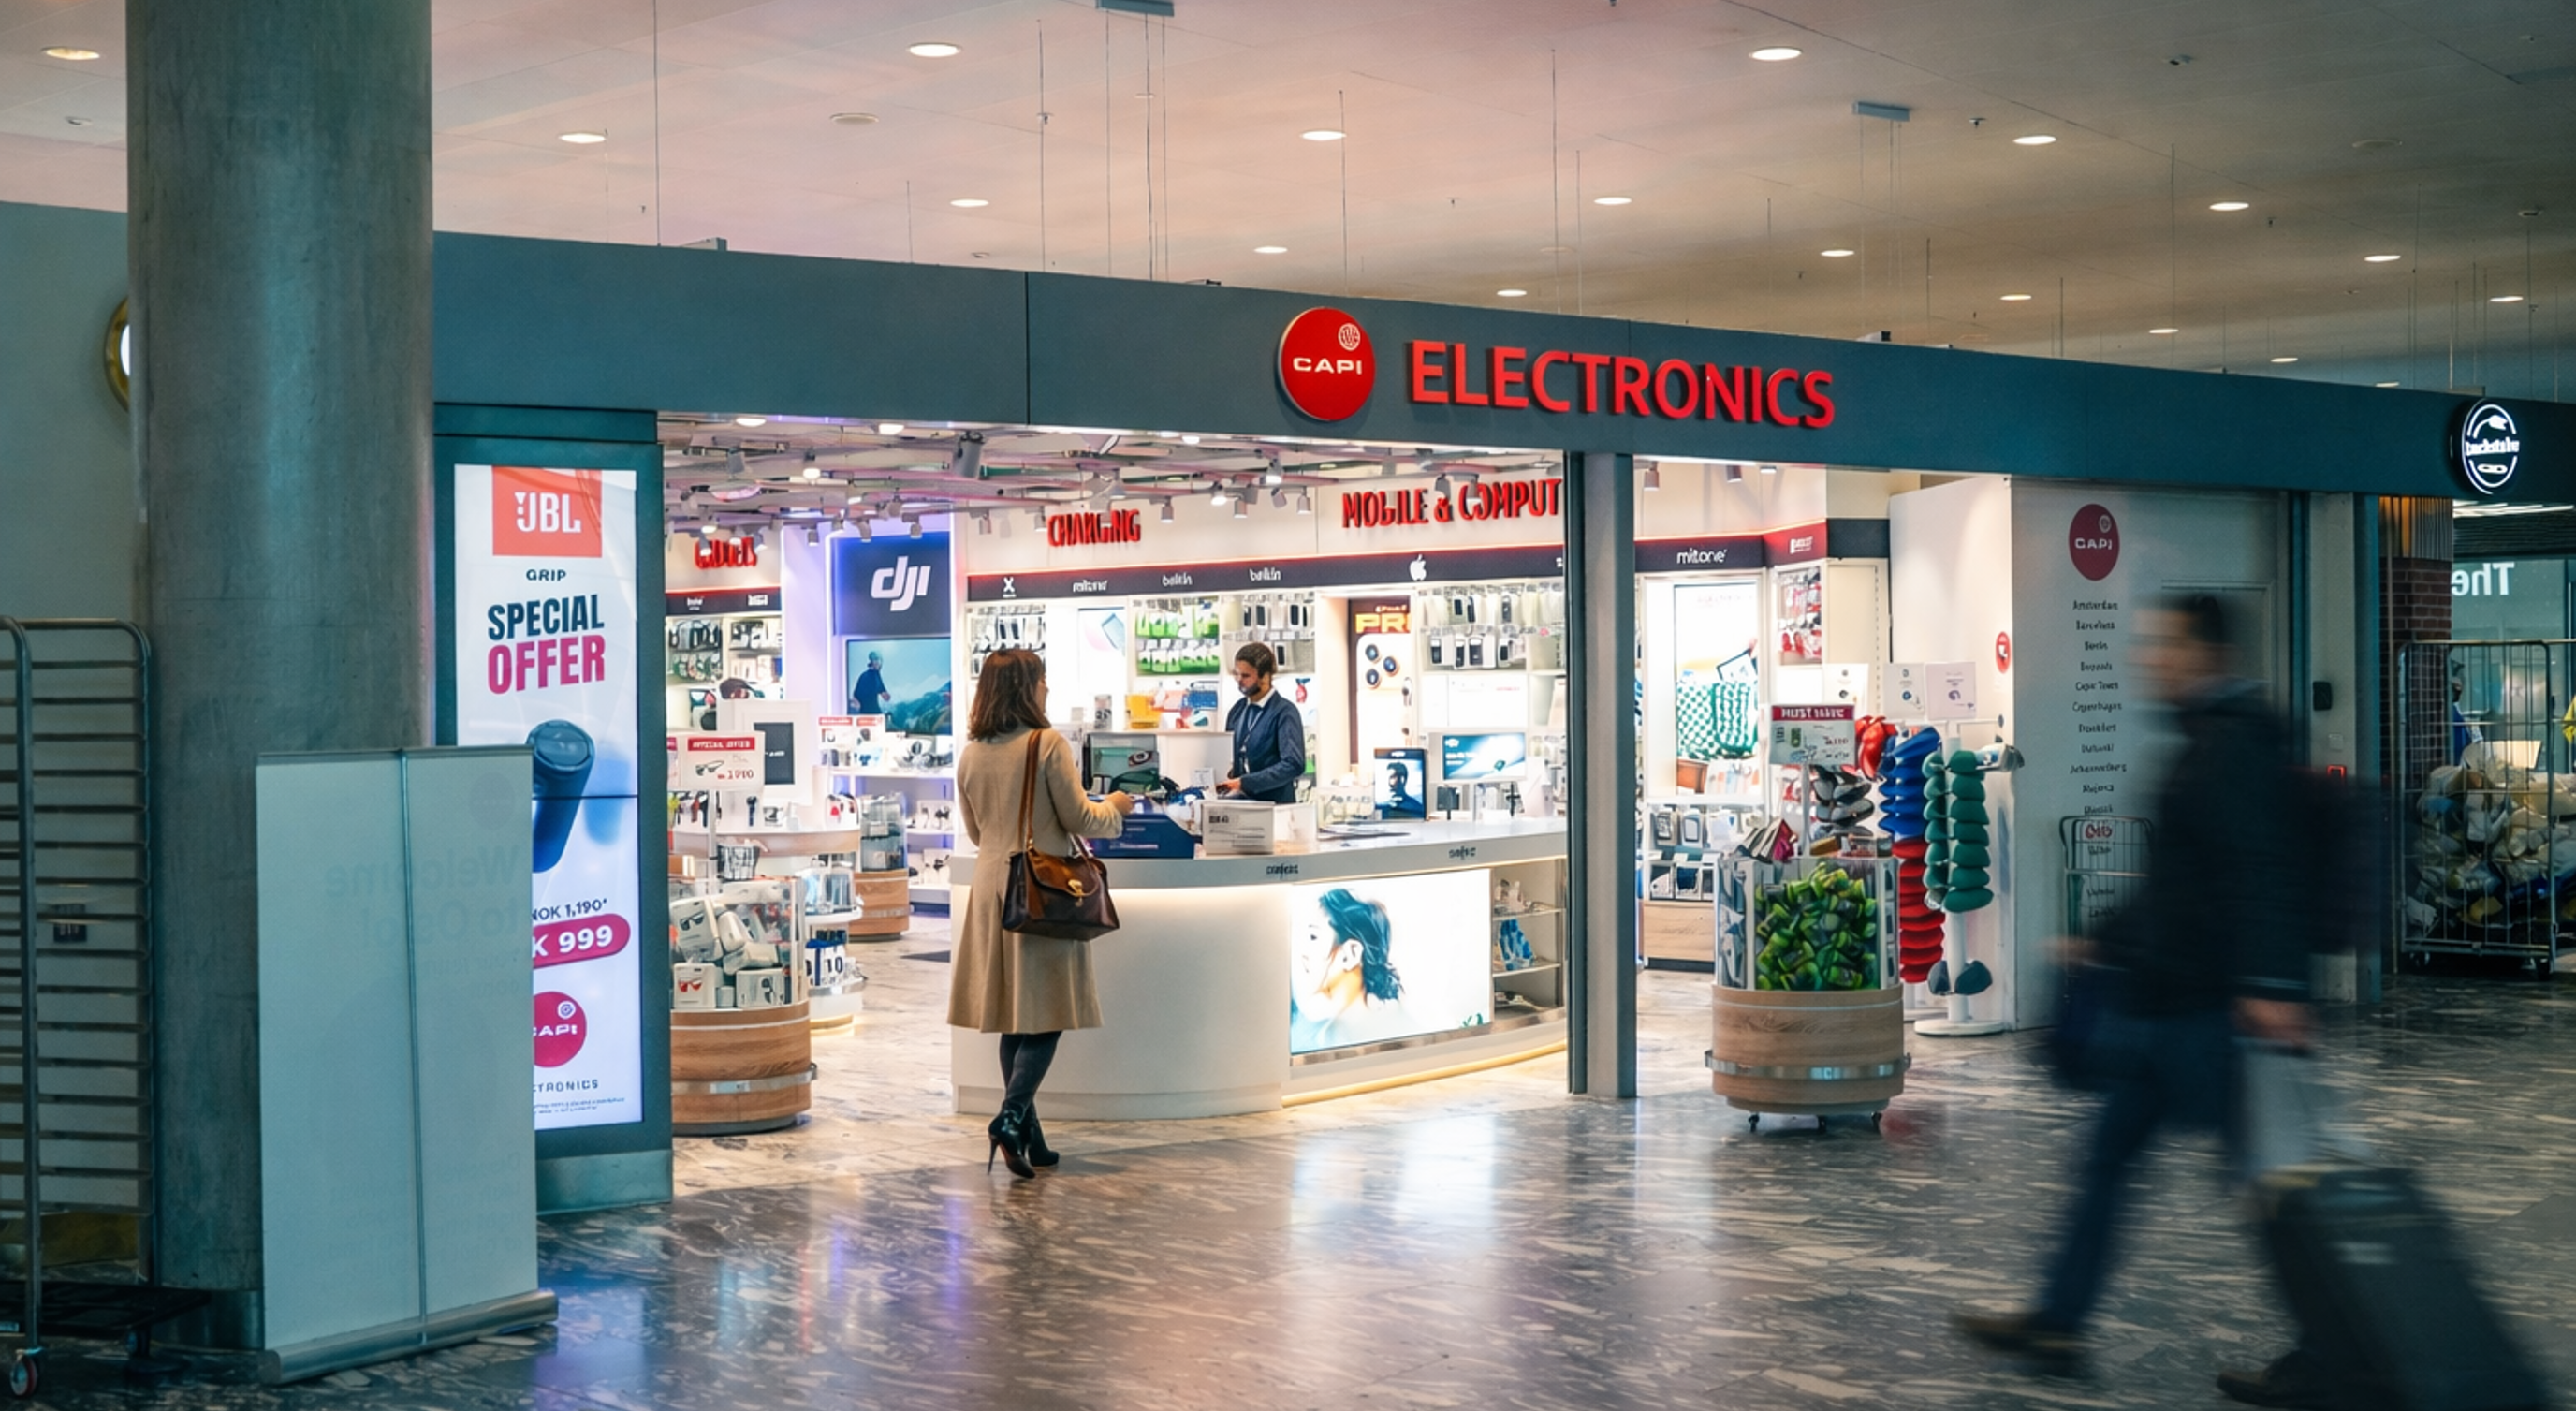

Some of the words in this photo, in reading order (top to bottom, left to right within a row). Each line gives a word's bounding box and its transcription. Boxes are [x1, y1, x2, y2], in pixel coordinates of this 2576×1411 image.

[1293, 357, 1363, 375] CAPI
[1410, 339, 1836, 429] ELECTRONICS
[514, 492, 582, 533] JBL
[525, 569, 567, 582] GRIP
[487, 594, 605, 641] SPECIAL
[1354, 614, 1411, 634] PR
[488, 634, 606, 695] OFFER
[558, 924, 613, 953] 999
